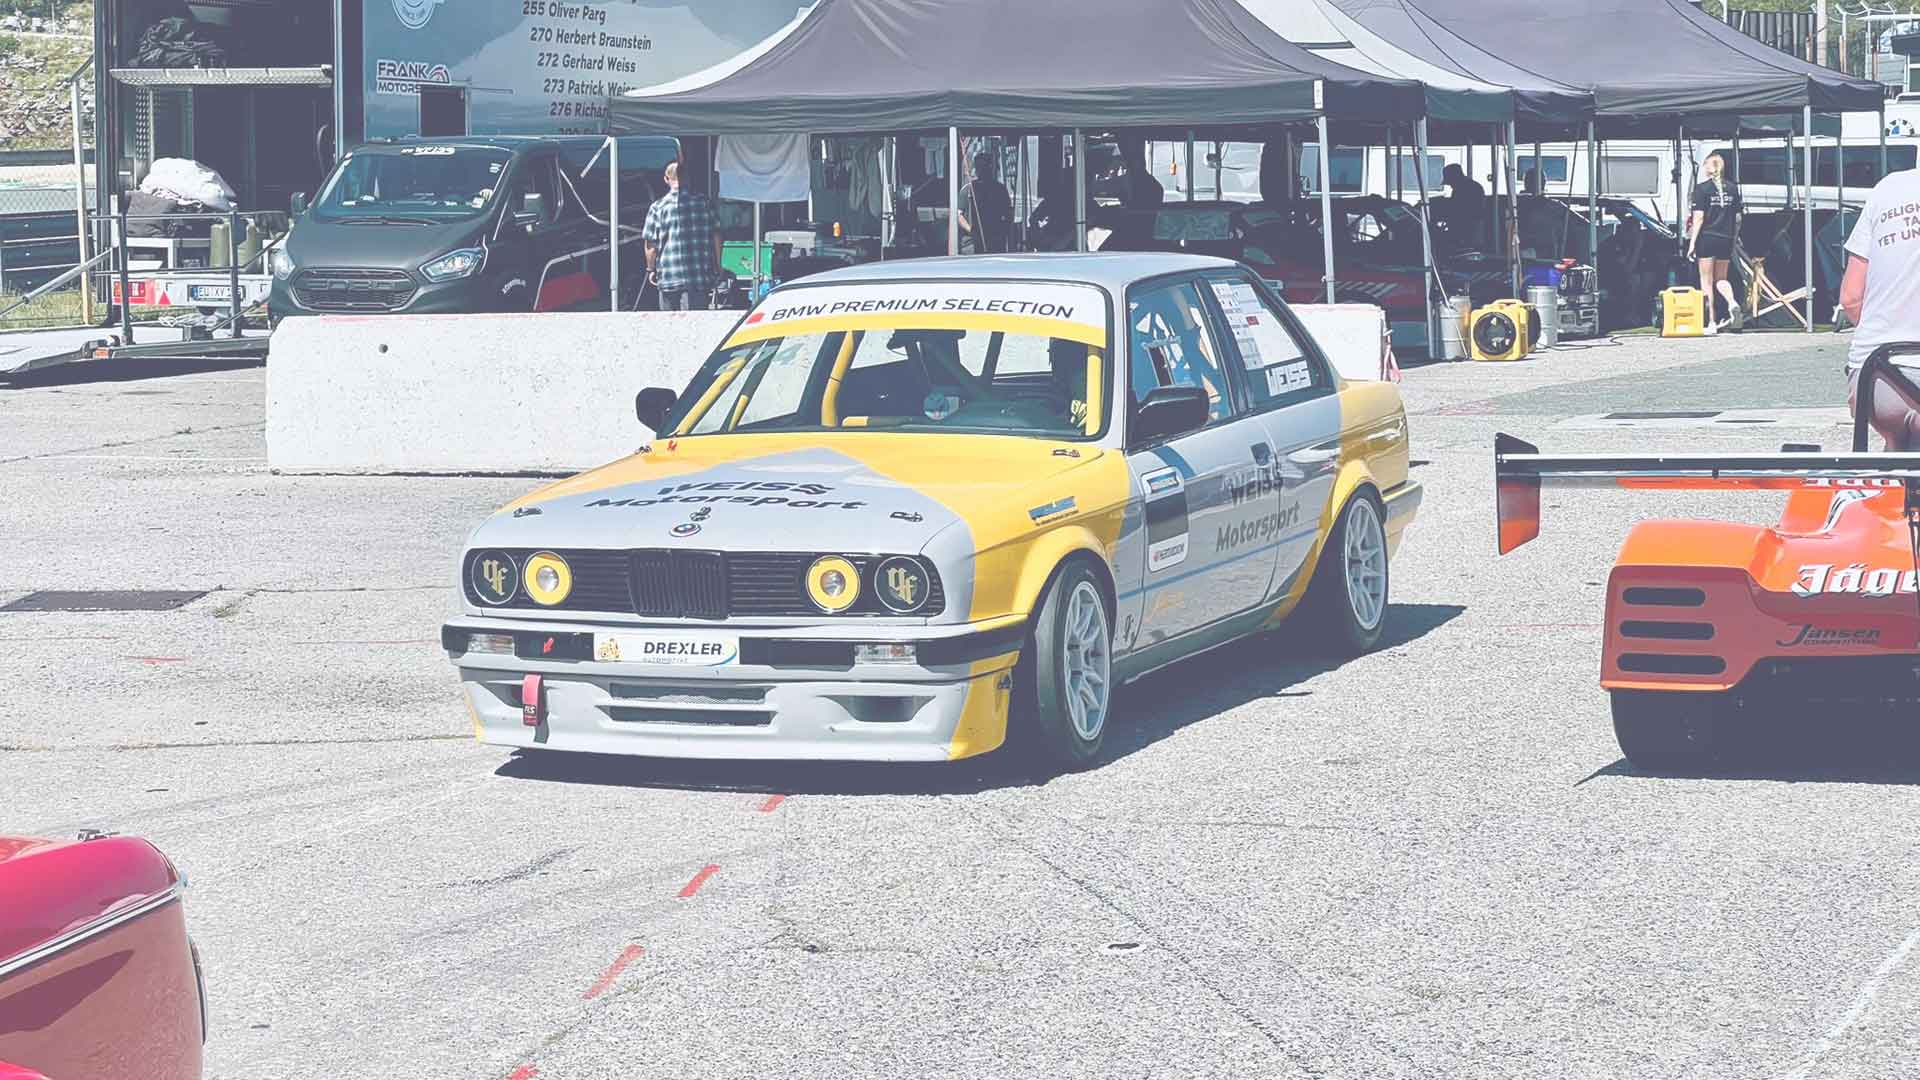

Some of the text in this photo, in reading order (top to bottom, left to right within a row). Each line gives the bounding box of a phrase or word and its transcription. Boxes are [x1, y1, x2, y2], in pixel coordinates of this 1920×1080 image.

[523, 1, 606, 25] 255 Oliver Parg
[530, 27, 651, 50] 270 Herbert Braunstein
[379, 62, 427, 78] FRANK
[537, 53, 636, 72] 272 Gerhard Weiss
[543, 78, 565, 93] 273
[568, 80, 604, 96] Patrick
[550, 102, 571, 116] 276
[1878, 233, 1896, 247] YET
[772, 299, 1074, 321] BMW PREMIUM SELECTION
[657, 482, 835, 495] WEISS
[585, 494, 868, 510] Motorsport
[1215, 501, 1299, 552] Motorsport
[644, 642, 722, 655] DREXLER
